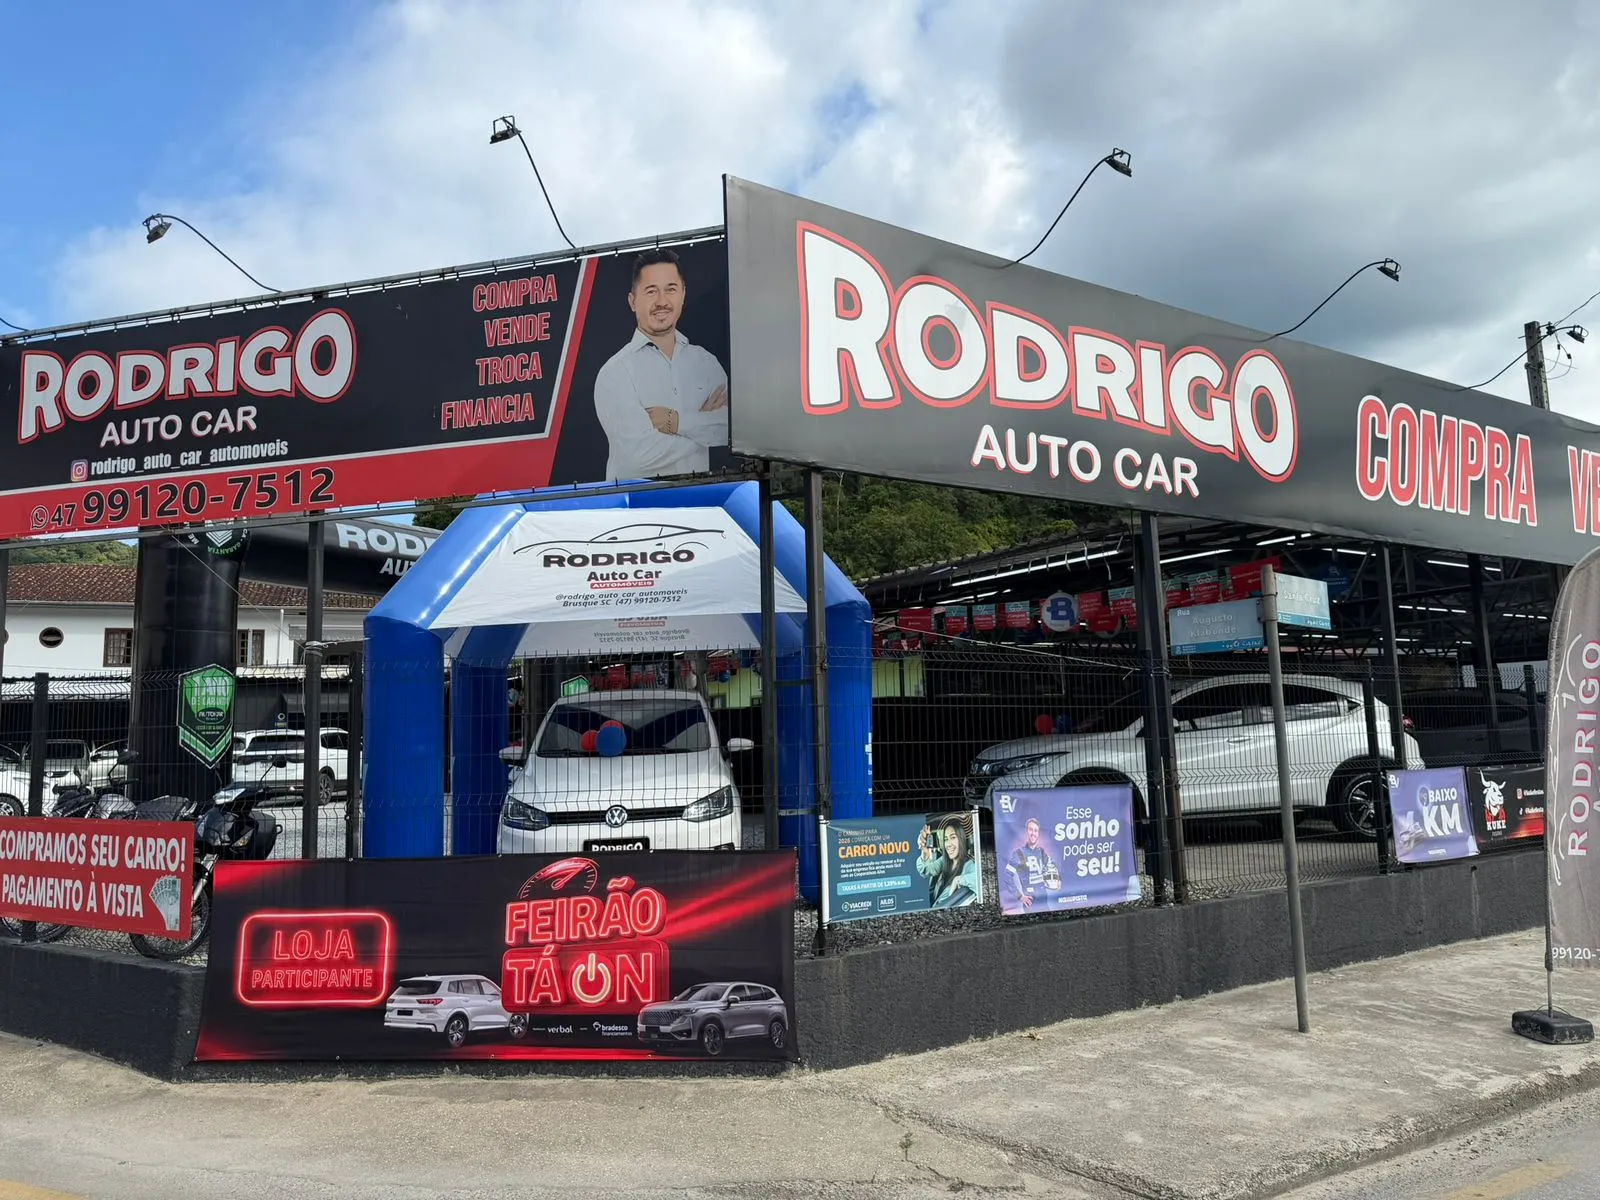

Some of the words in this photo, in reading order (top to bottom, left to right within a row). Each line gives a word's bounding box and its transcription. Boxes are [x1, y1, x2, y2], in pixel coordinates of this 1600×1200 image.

[473, 274, 558, 312] COMPRA
[484, 312, 550, 347] VENDE
[797, 220, 1299, 482] RODRIGO
[17, 307, 357, 444] RODRIGO
[476, 352, 542, 386] TROCA
[100, 413, 182, 448] AUTO
[190, 405, 257, 437] CAR
[440, 392, 535, 430] FINANCIA
[90, 439, 288, 475] rodrigo_auto_car_automoveis
[970, 424, 1101, 483] AUTO
[1112, 447, 1199, 498] CAR
[1356, 394, 1538, 527] COMPRA
[51, 503, 76, 526] 47
[83, 467, 336, 525] 99120-7512
[336, 523, 436, 556] ROD
[543, 550, 695, 568] RODRIGO
[587, 571, 629, 582] Auto
[633, 569, 662, 580] Car
[562, 600, 598, 608] Brusque
[601, 598, 611, 606] SC
[615, 597, 632, 606] (47)
[634, 595, 681, 605] 99120-7512
[1177, 609, 1191, 617] Rua
[1192, 614, 1233, 626] Augusto
[1568, 641, 1600, 856] RODRIGO
[1429, 787, 1457, 803] BAIXO
[1054, 815, 1120, 841] sonho
[1066, 806, 1092, 820] Esse
[1422, 803, 1463, 837] KM
[0, 830, 86, 865] COMPRAMOS
[90, 834, 119, 868] SEU
[125, 836, 186, 872] CARRO!
[839, 844, 877, 859] CARRO
[879, 841, 910, 855] NOVO
[1063, 842, 1096, 860] pode
[1096, 840, 1115, 853] ser
[1077, 851, 1120, 877] seu!
[2, 873, 83, 911] PAGAMENTO
[86, 871, 97, 913] À
[102, 882, 143, 918] VISTA
[506, 876, 667, 946] FEIRÃO
[849, 901, 872, 909] VIACREDI
[273, 929, 355, 960] LOJA
[1552, 946, 1600, 960] 99120-
[251, 968, 373, 988] PARTICIPANTE
[506, 944, 562, 1004] TÁ
[570, 952, 653, 1005] ON
